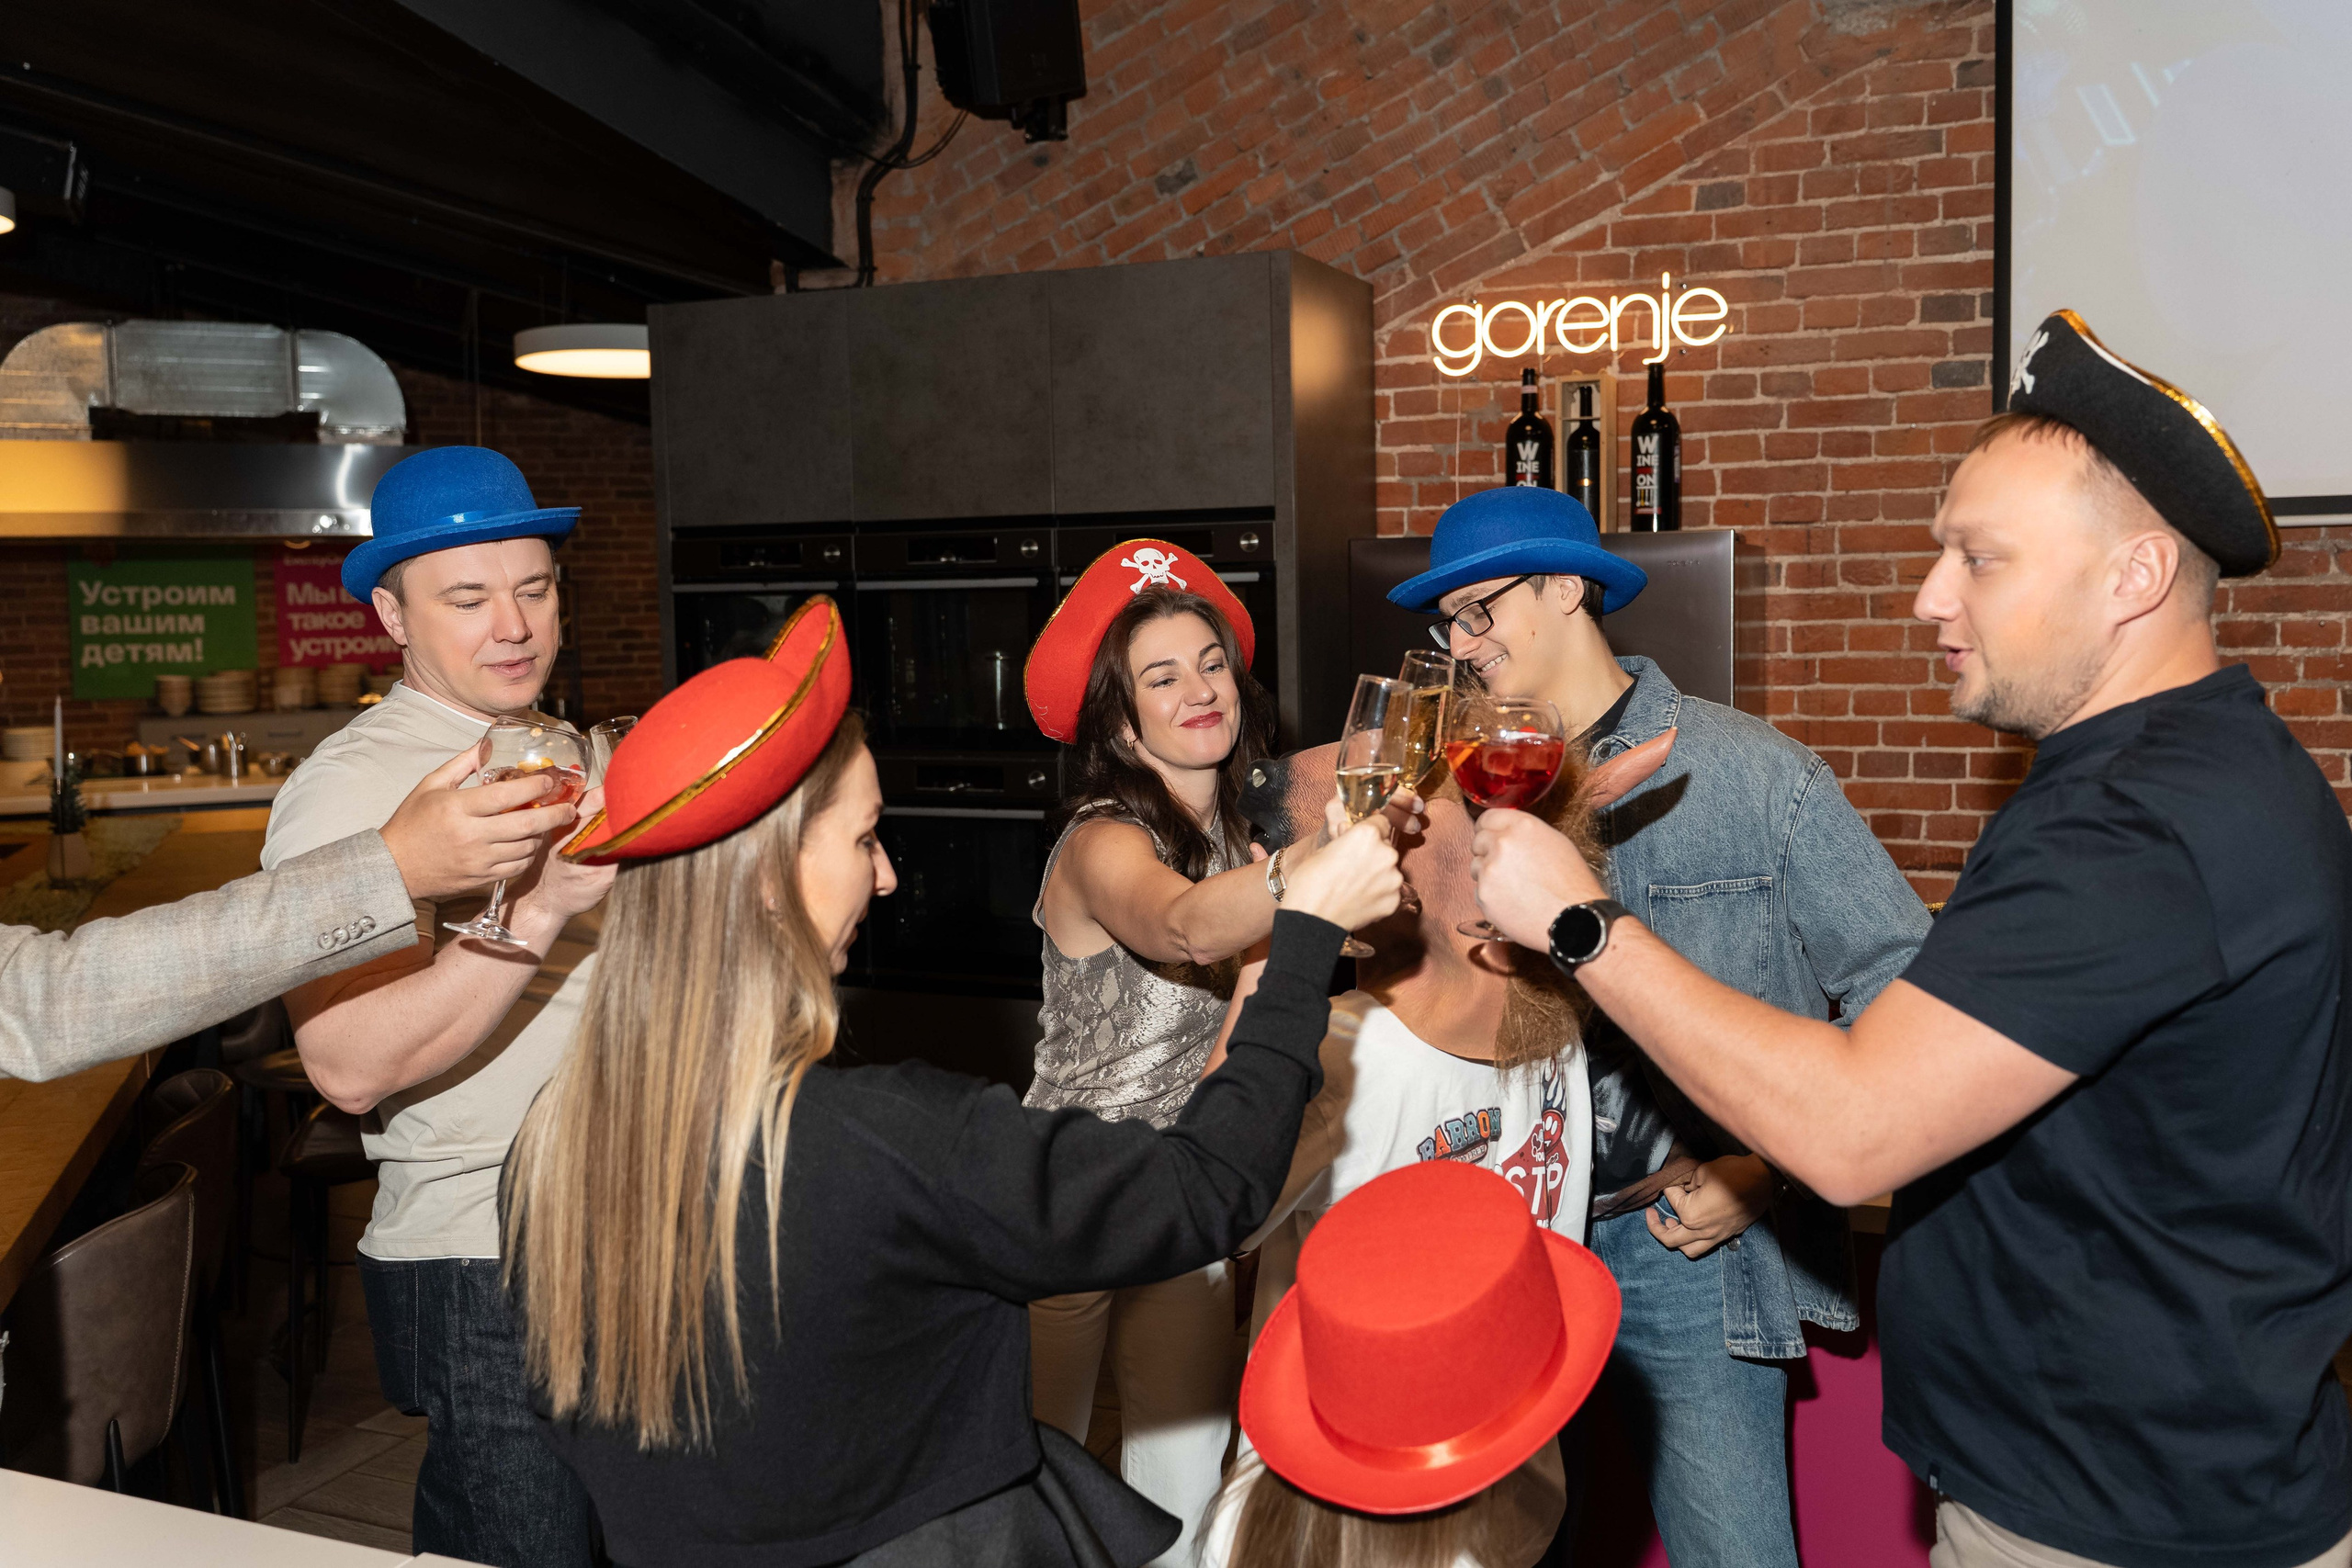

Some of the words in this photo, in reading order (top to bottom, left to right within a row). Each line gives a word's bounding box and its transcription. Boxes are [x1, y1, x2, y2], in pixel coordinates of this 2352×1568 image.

[1432, 271, 1729, 378] gorenje
[78, 580, 236, 613] Устроим
[286, 581, 337, 605] Мы
[81, 614, 206, 636] вашим
[287, 610, 367, 632] такое
[80, 637, 204, 669] детям!
